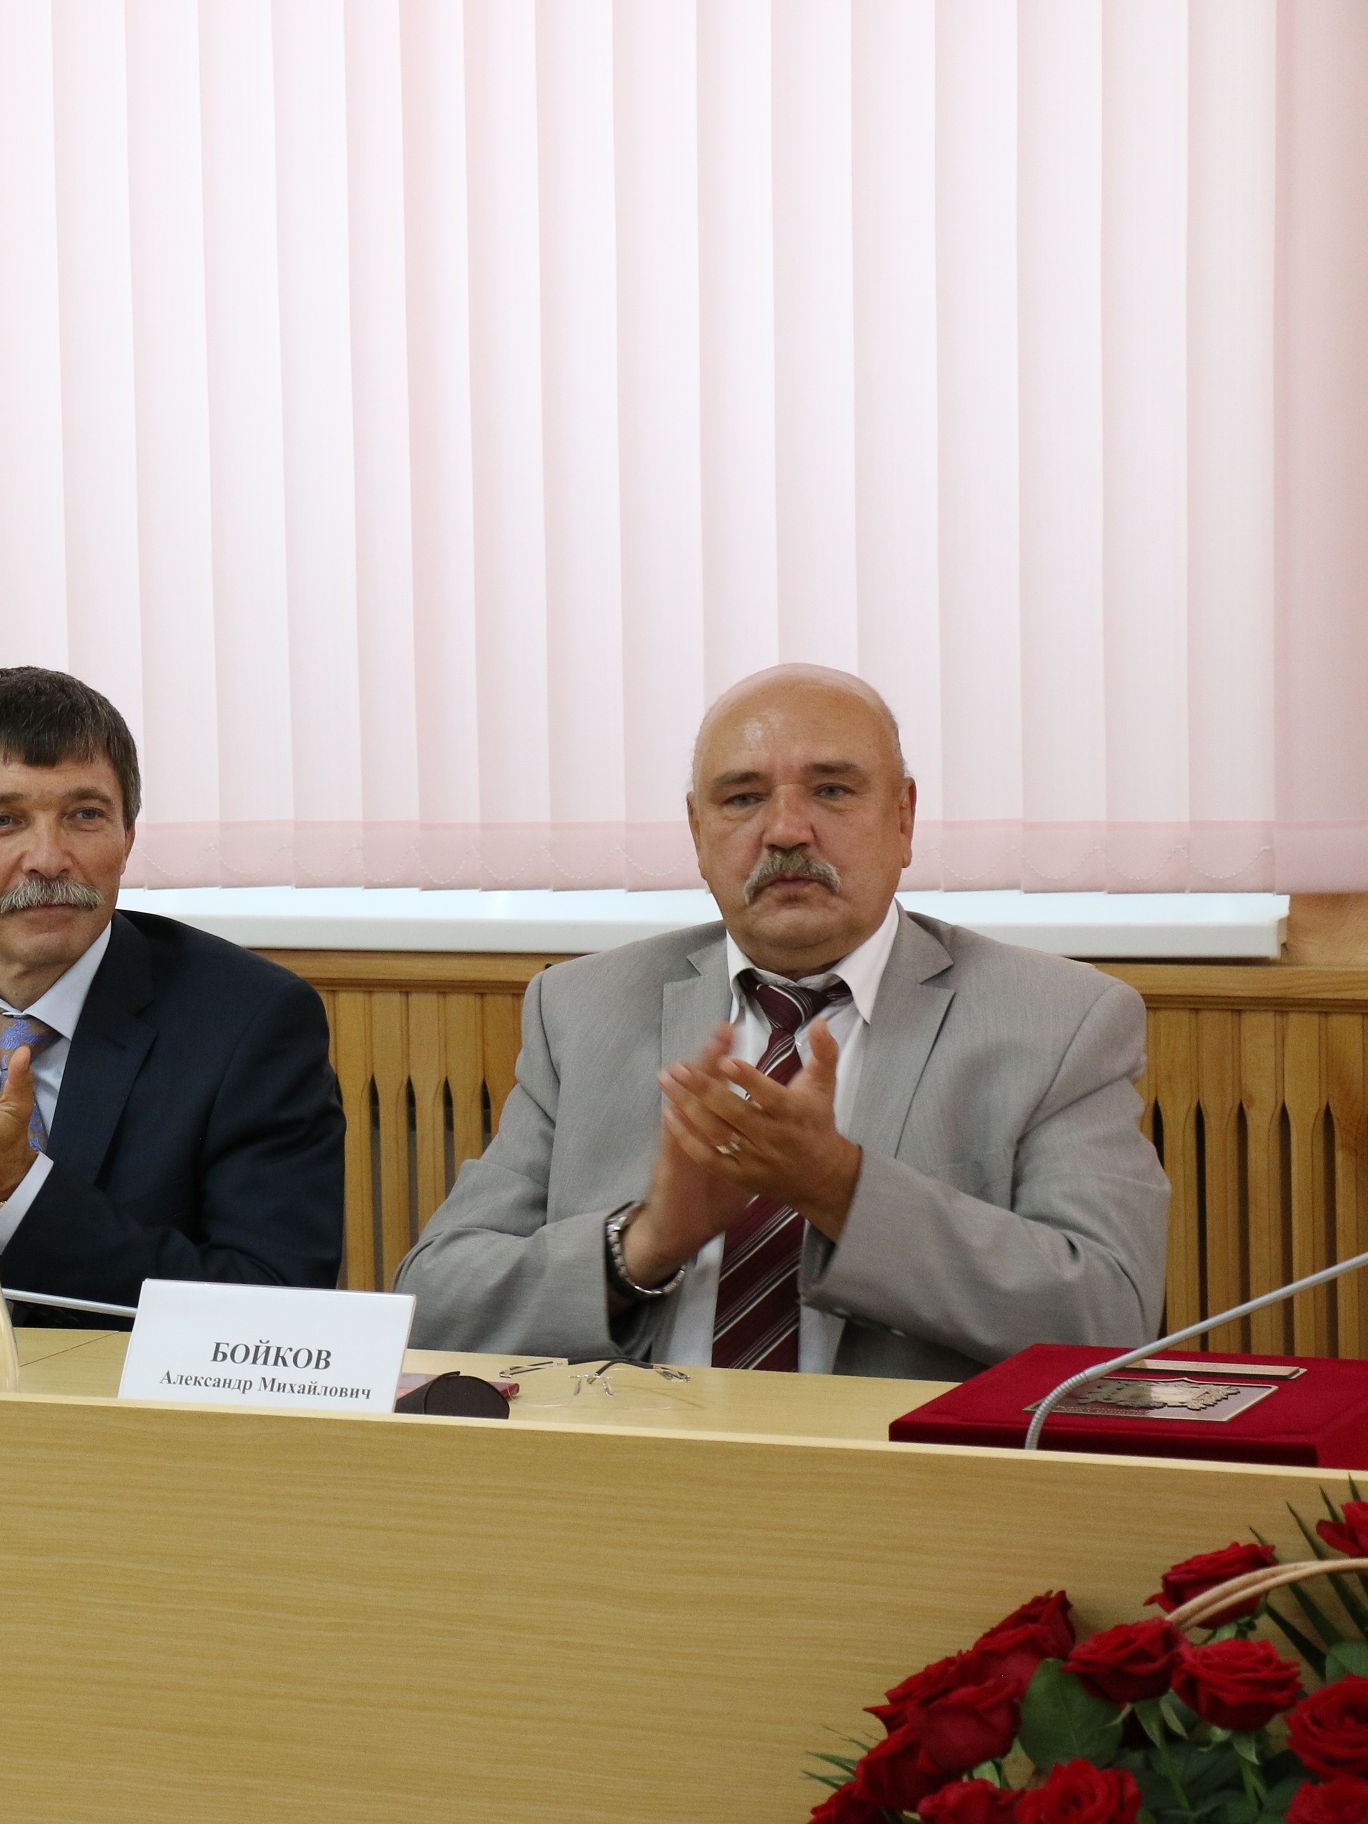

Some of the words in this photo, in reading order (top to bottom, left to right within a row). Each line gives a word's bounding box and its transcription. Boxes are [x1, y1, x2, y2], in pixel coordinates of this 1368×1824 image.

[211, 1339, 332, 1371] БОЙКОВ
[160, 1370, 253, 1395] Александр
[259, 1377, 372, 1400] Михайлович
